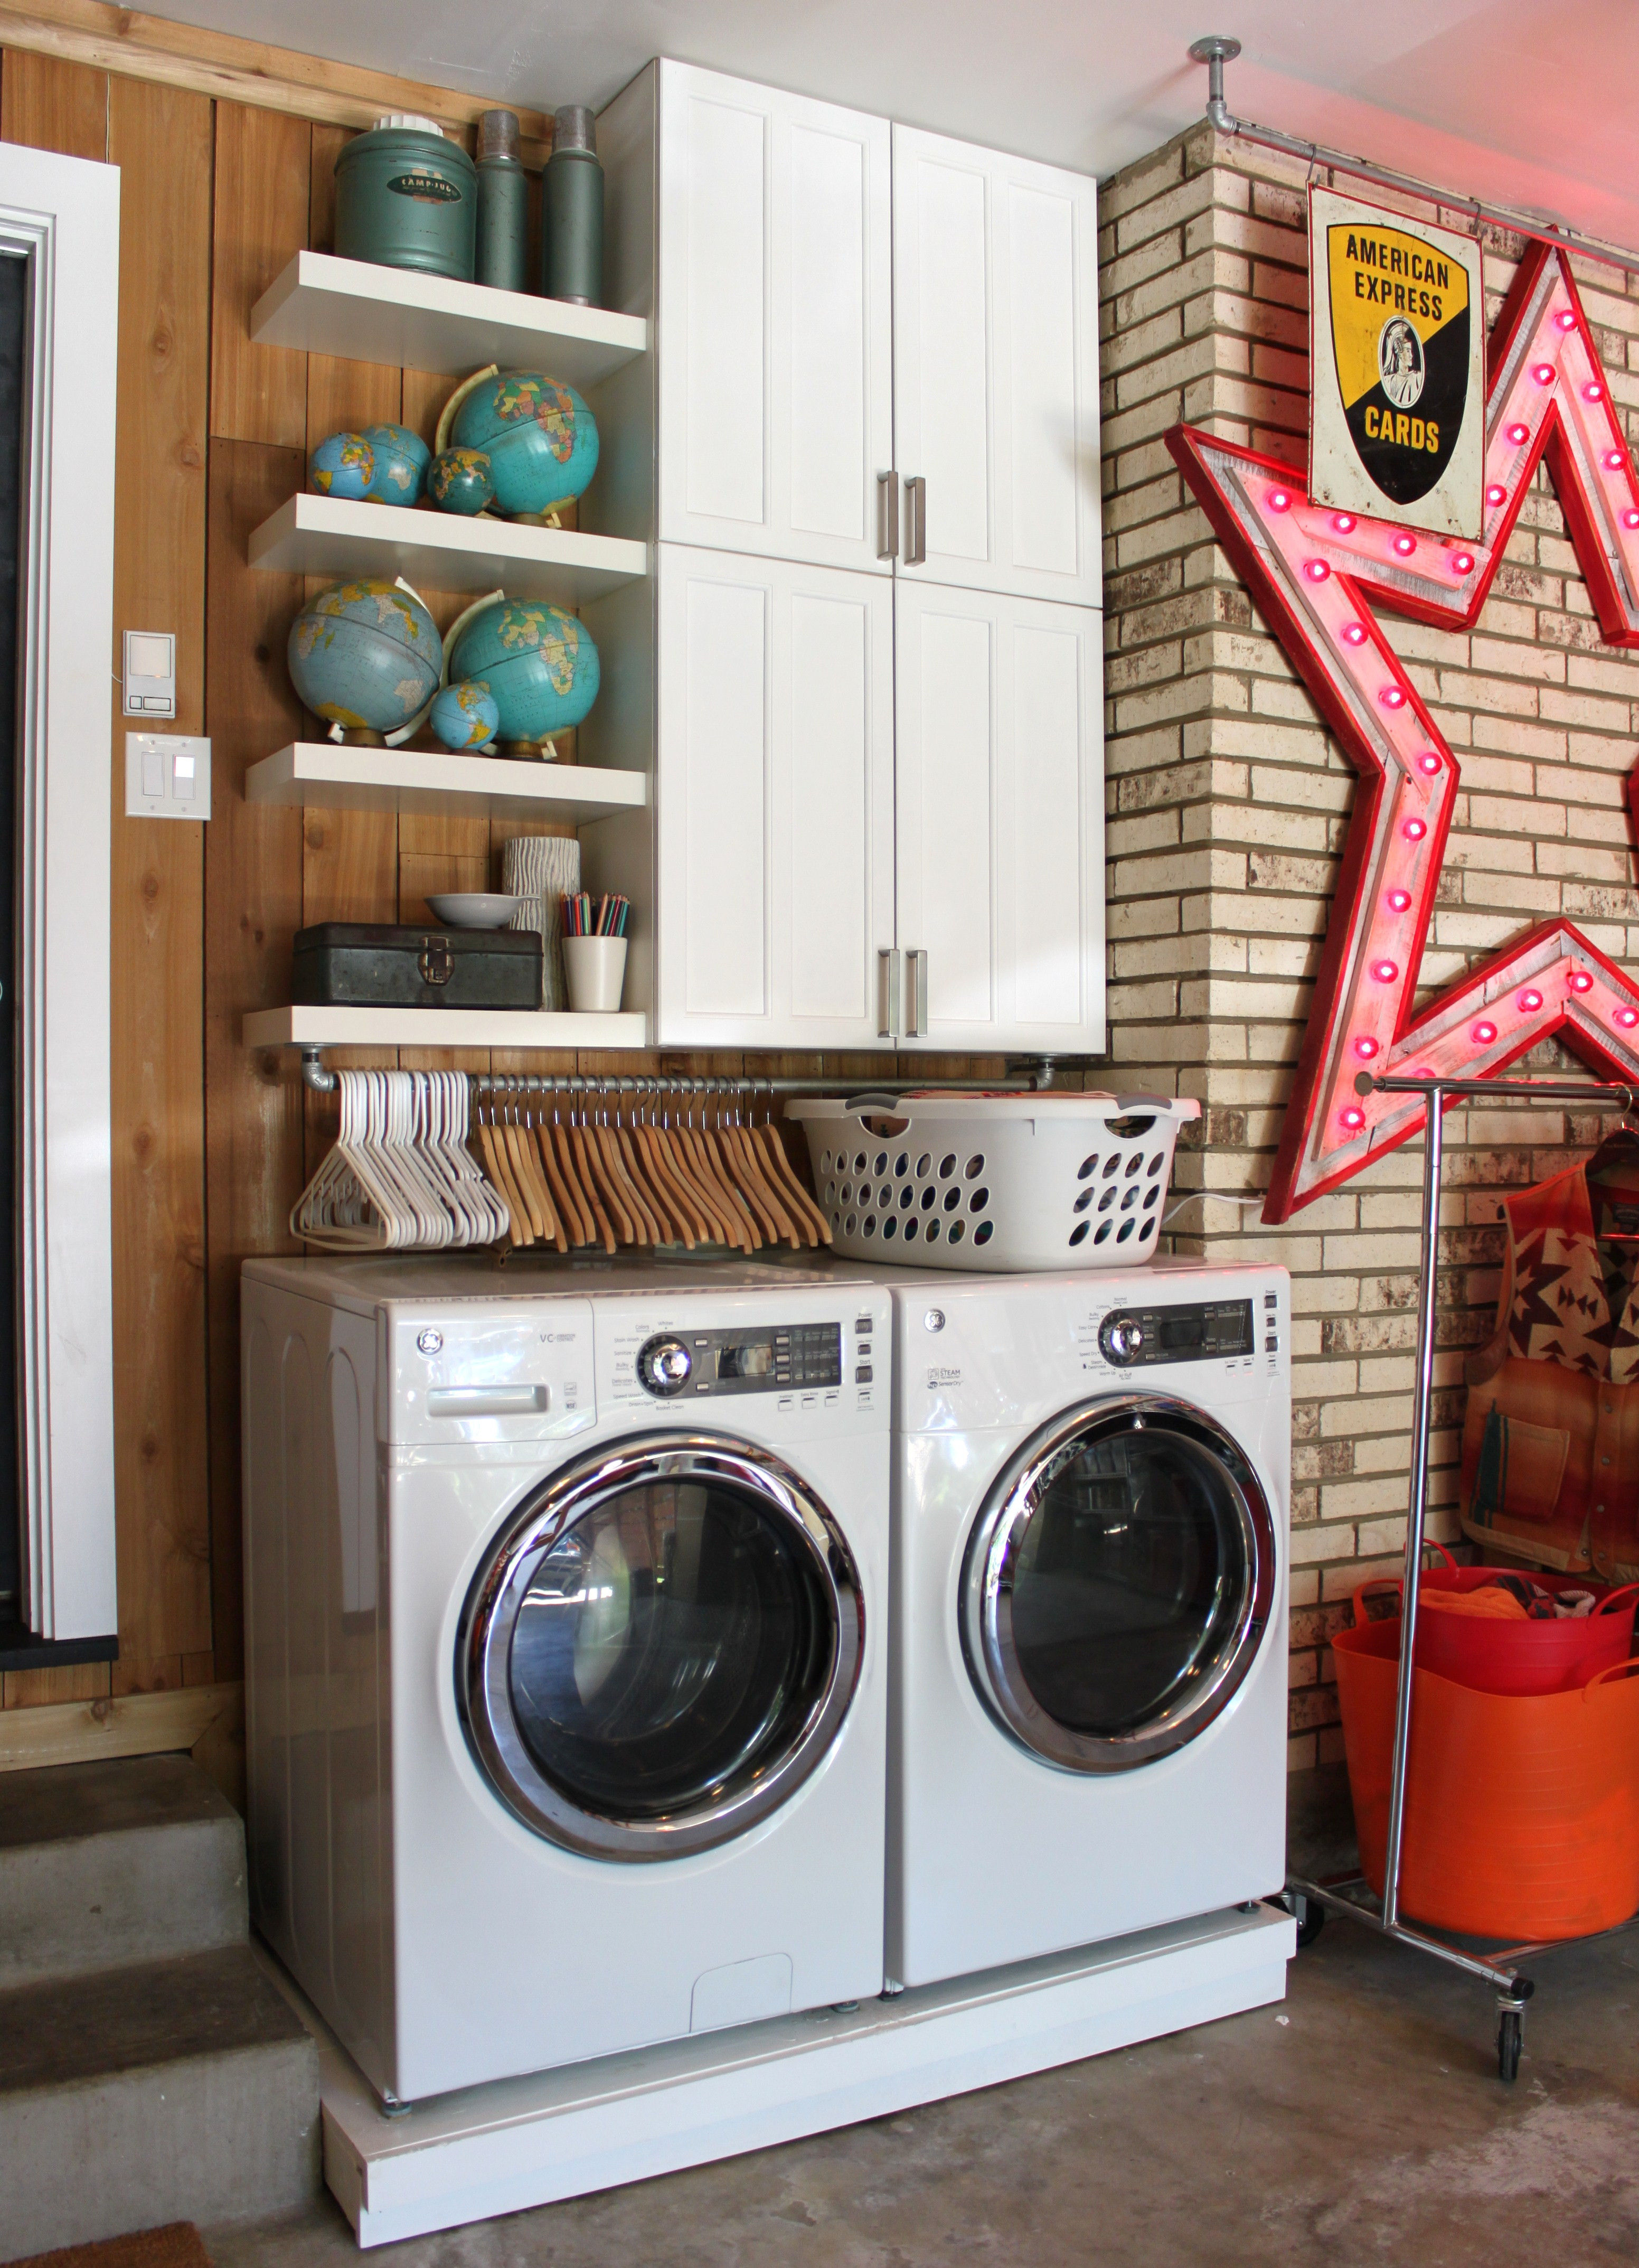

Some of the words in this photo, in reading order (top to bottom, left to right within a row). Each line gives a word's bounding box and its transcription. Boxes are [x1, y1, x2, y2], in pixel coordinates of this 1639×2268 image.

[1346, 234, 1448, 289] AMERICAN
[1355, 271, 1442, 321] EXPRESS
[1365, 406, 1439, 453] CARDS
[540, 1334, 553, 1343] VC
